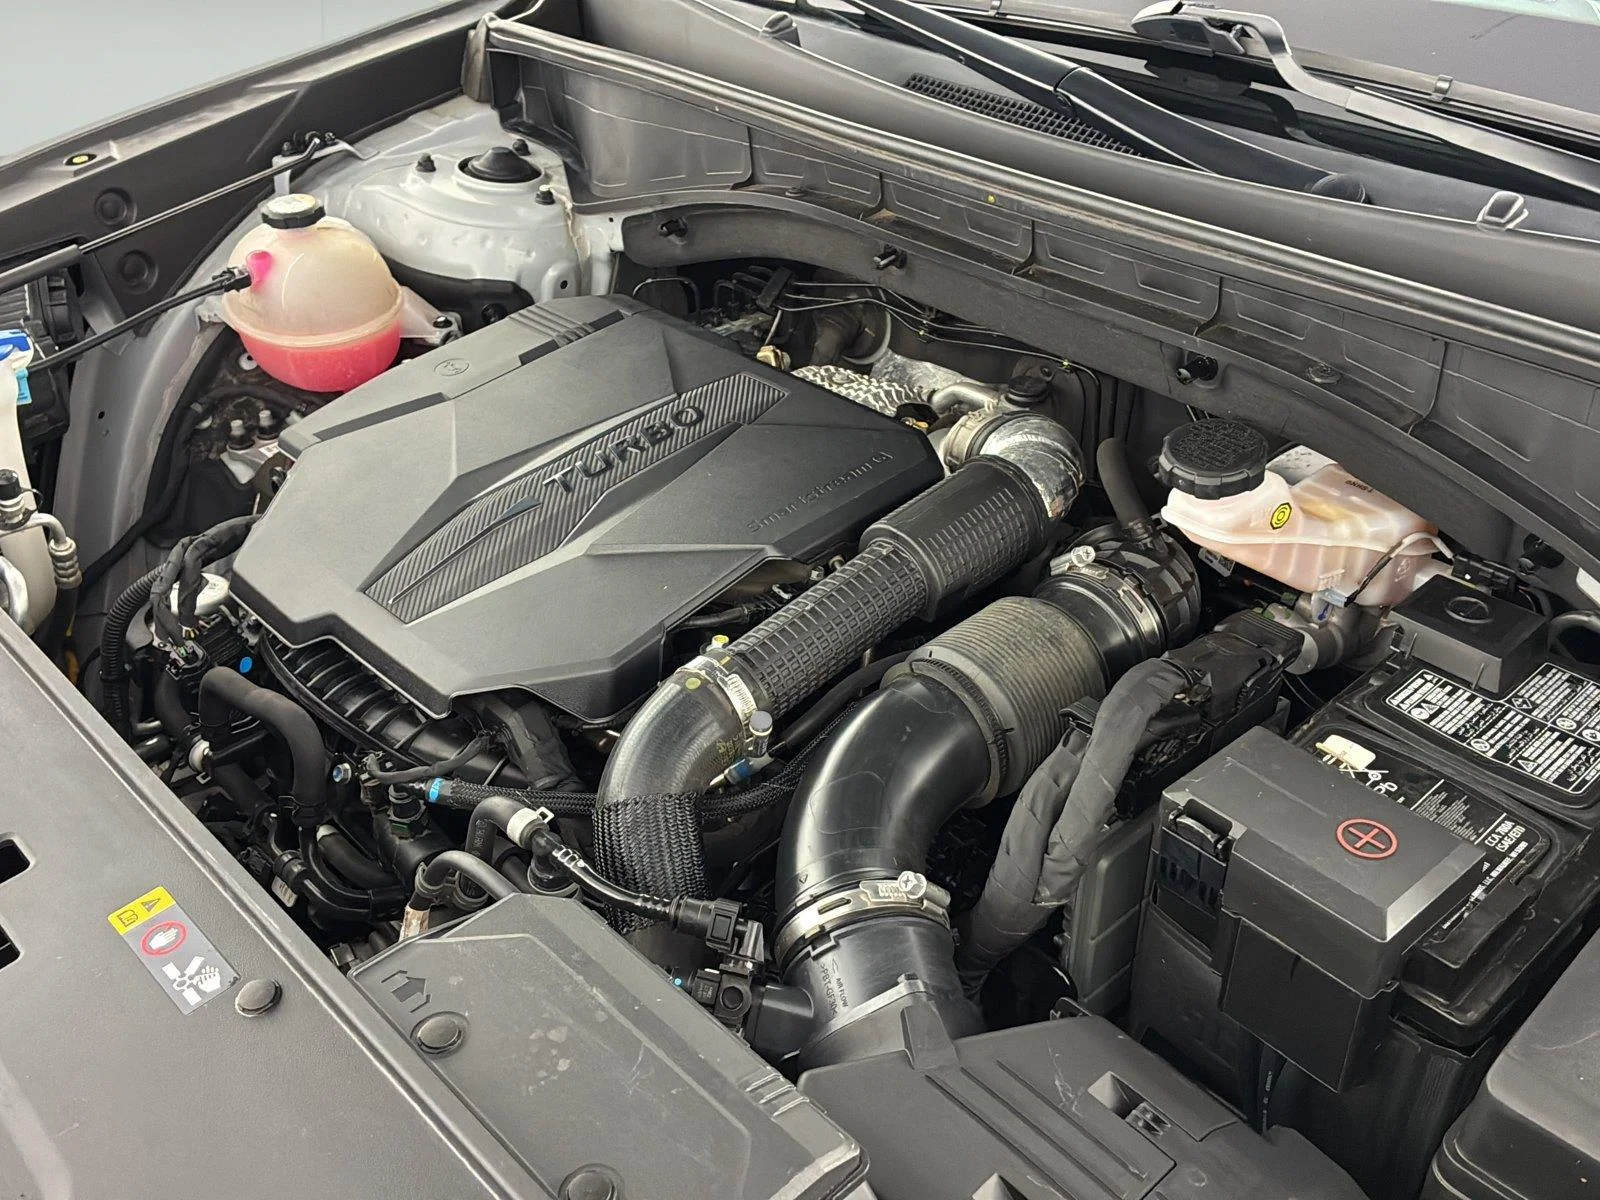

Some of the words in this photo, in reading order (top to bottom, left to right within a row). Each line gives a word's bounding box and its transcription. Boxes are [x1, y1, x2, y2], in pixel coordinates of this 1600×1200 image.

[543, 406, 705, 493] TURBO
[1484, 833, 1502, 847] CCA
[839, 988, 848, 1007] FLOW
